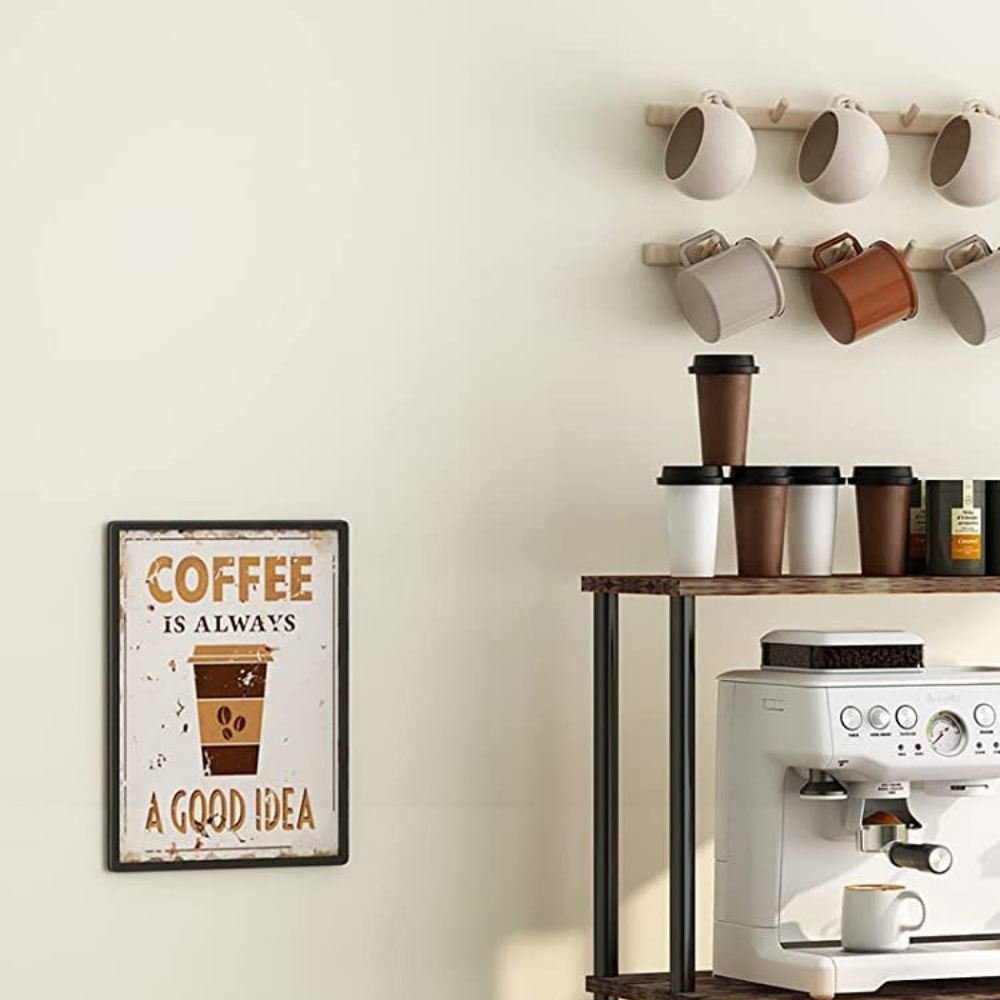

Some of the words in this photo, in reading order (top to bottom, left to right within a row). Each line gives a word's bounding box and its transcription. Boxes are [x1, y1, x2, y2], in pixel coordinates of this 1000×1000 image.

[147, 555, 314, 604] COFFEE
[163, 615, 186, 633] IS
[194, 614, 297, 633] ALWAYS
[145, 791, 164, 834] A
[170, 788, 247, 835] GOOD
[255, 787, 316, 832] IDEA
